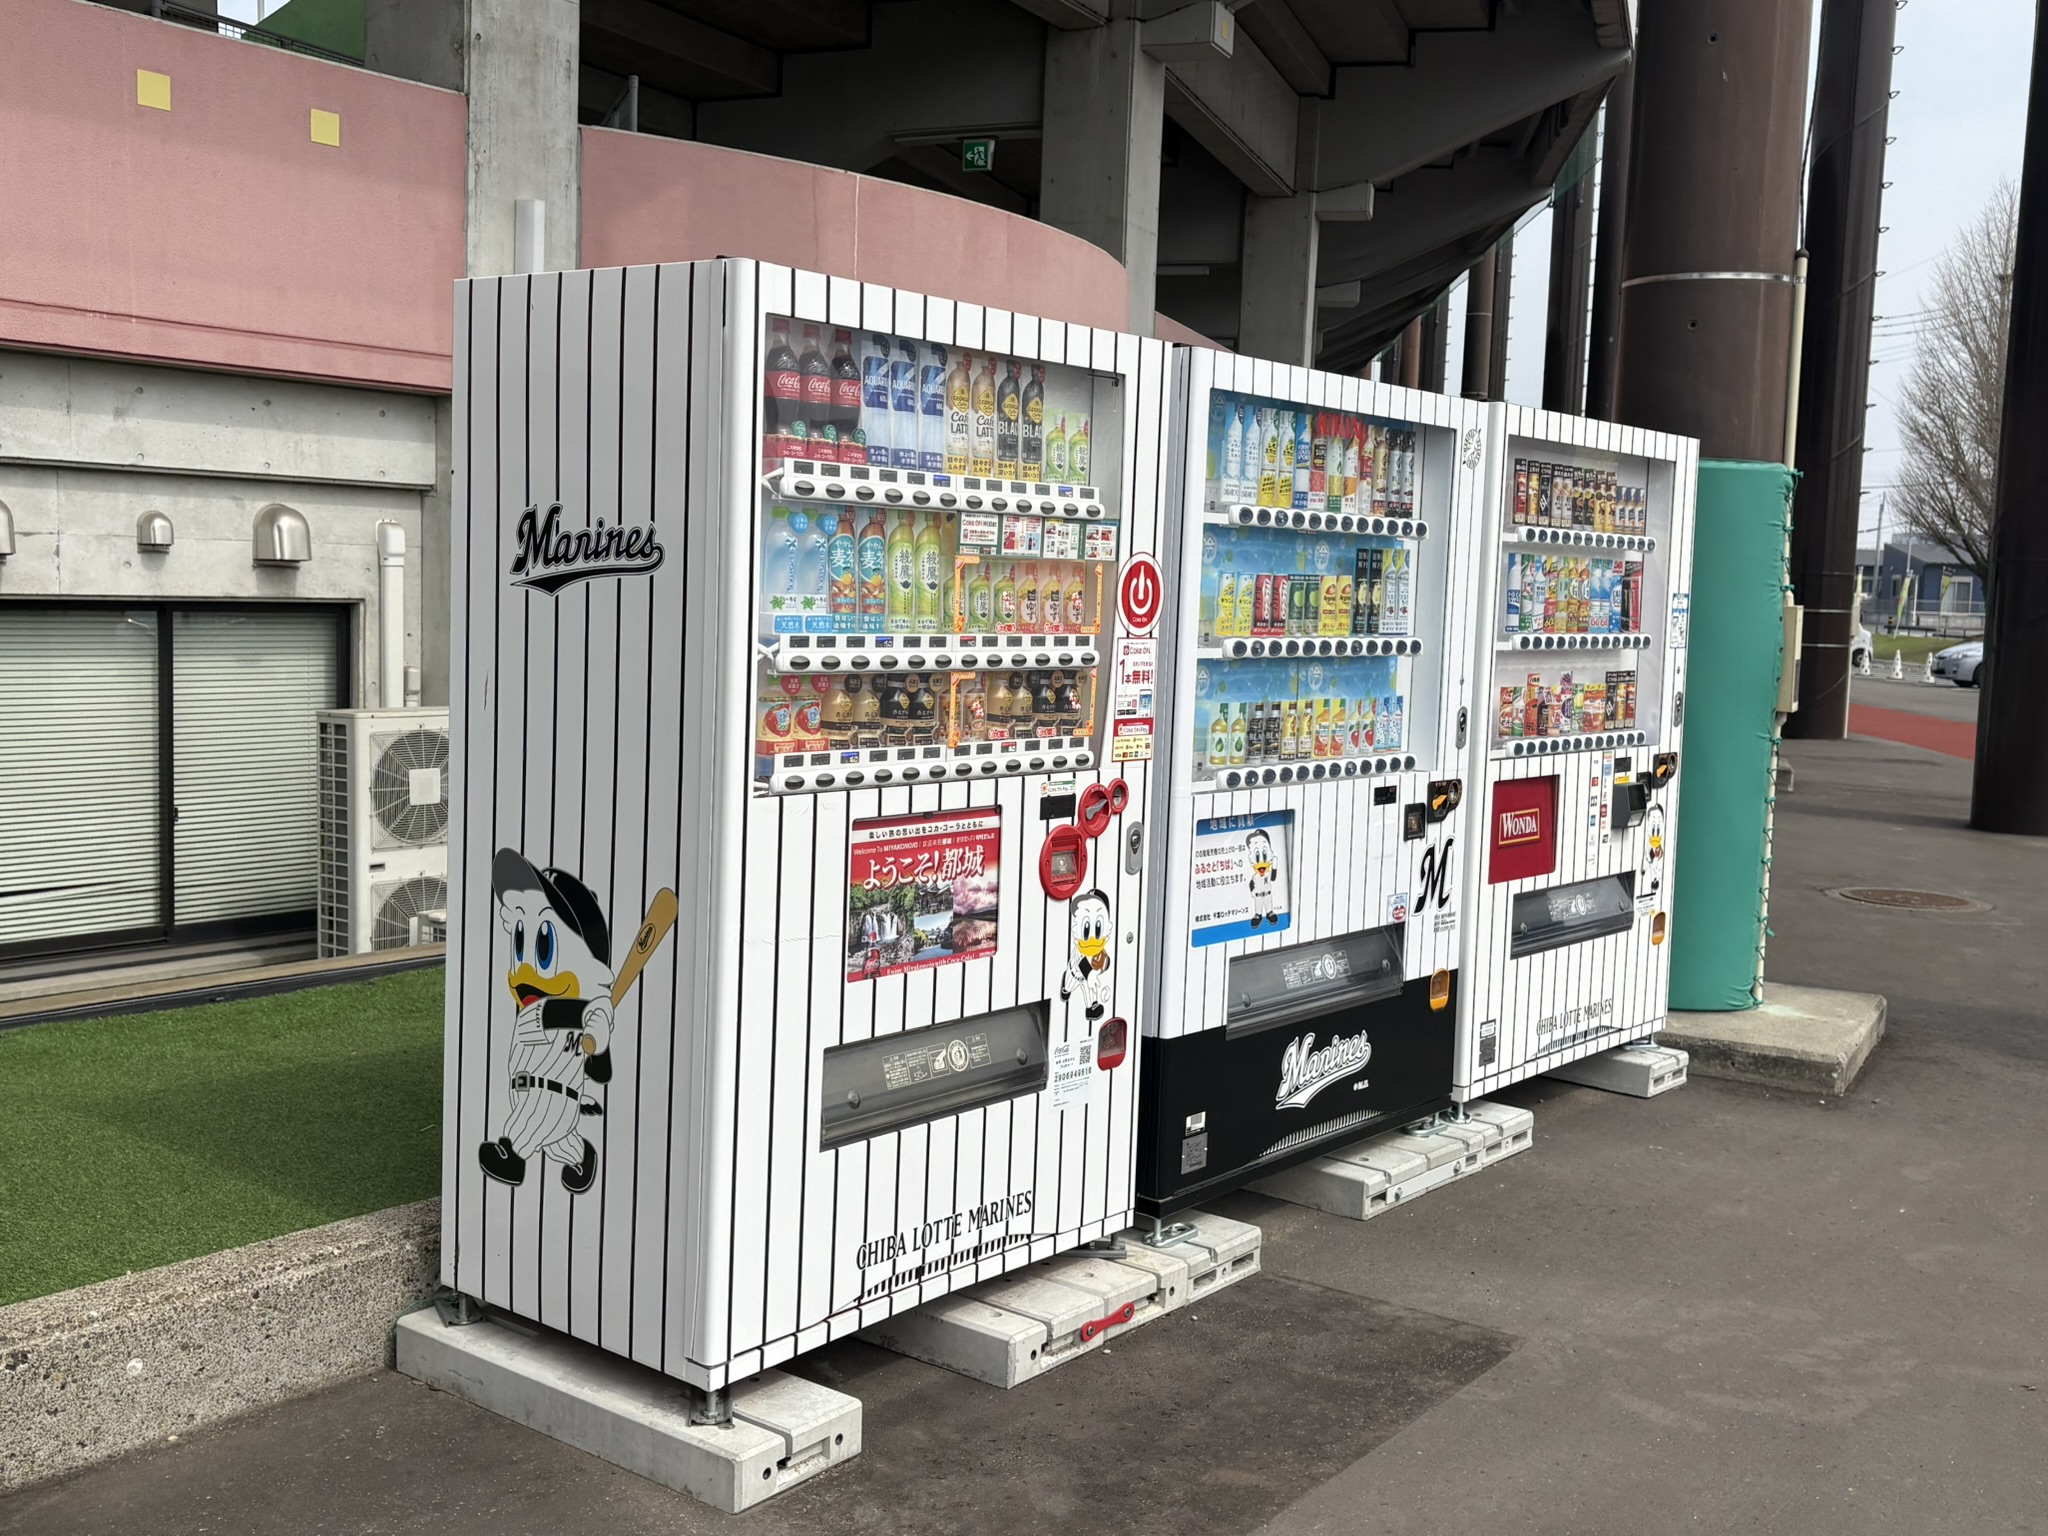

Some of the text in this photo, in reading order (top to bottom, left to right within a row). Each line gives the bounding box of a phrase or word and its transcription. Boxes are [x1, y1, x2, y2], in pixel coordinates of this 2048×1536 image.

[1317, 411, 1363, 440] KIRIN
[510, 503, 665, 576] Marines
[1502, 812, 1537, 839] WONDA
[884, 842, 918, 852] MIYAKONOJO
[863, 844, 985, 890] ようこそ!都城
[1411, 835, 1455, 916] M
[1213, 907, 1249, 919] 千葉ロッテマリーンズ
[887, 968, 903, 976] Enjoy
[935, 959, 946, 967] with
[1536, 998, 1613, 1036] CHIBA LOTTE MARINES
[564, 1031, 584, 1056] M
[1276, 1029, 1371, 1101] Marines
[856, 1190, 1033, 1271] CHIBA LOTTE MARINES
